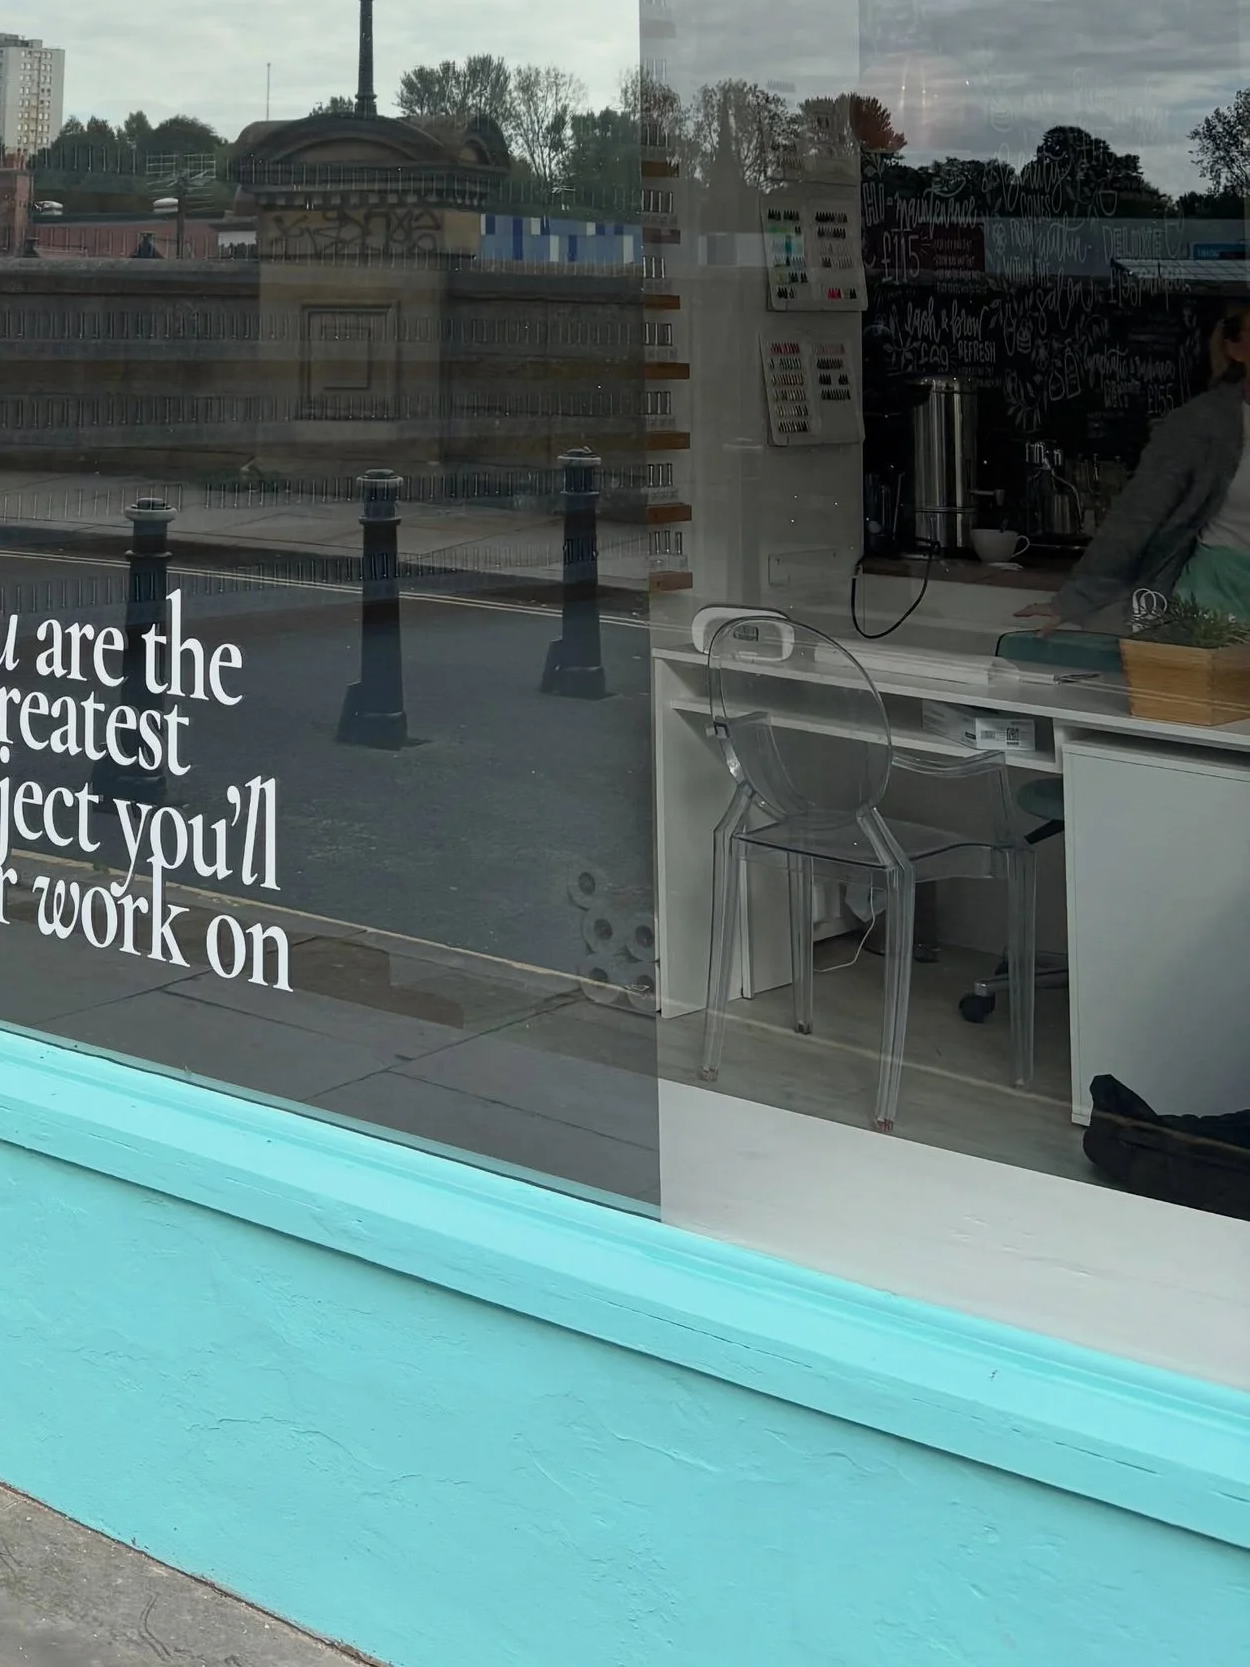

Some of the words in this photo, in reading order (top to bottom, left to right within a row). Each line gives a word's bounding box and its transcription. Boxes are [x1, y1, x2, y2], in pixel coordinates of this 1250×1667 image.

[881, 231, 920, 285] £115
[957, 339, 996, 364] REFRESH
[35, 618, 127, 688] are
[142, 588, 245, 706] the
[110, 775, 281, 898] you'll
[31, 856, 191, 968] work
[206, 914, 294, 993] on
